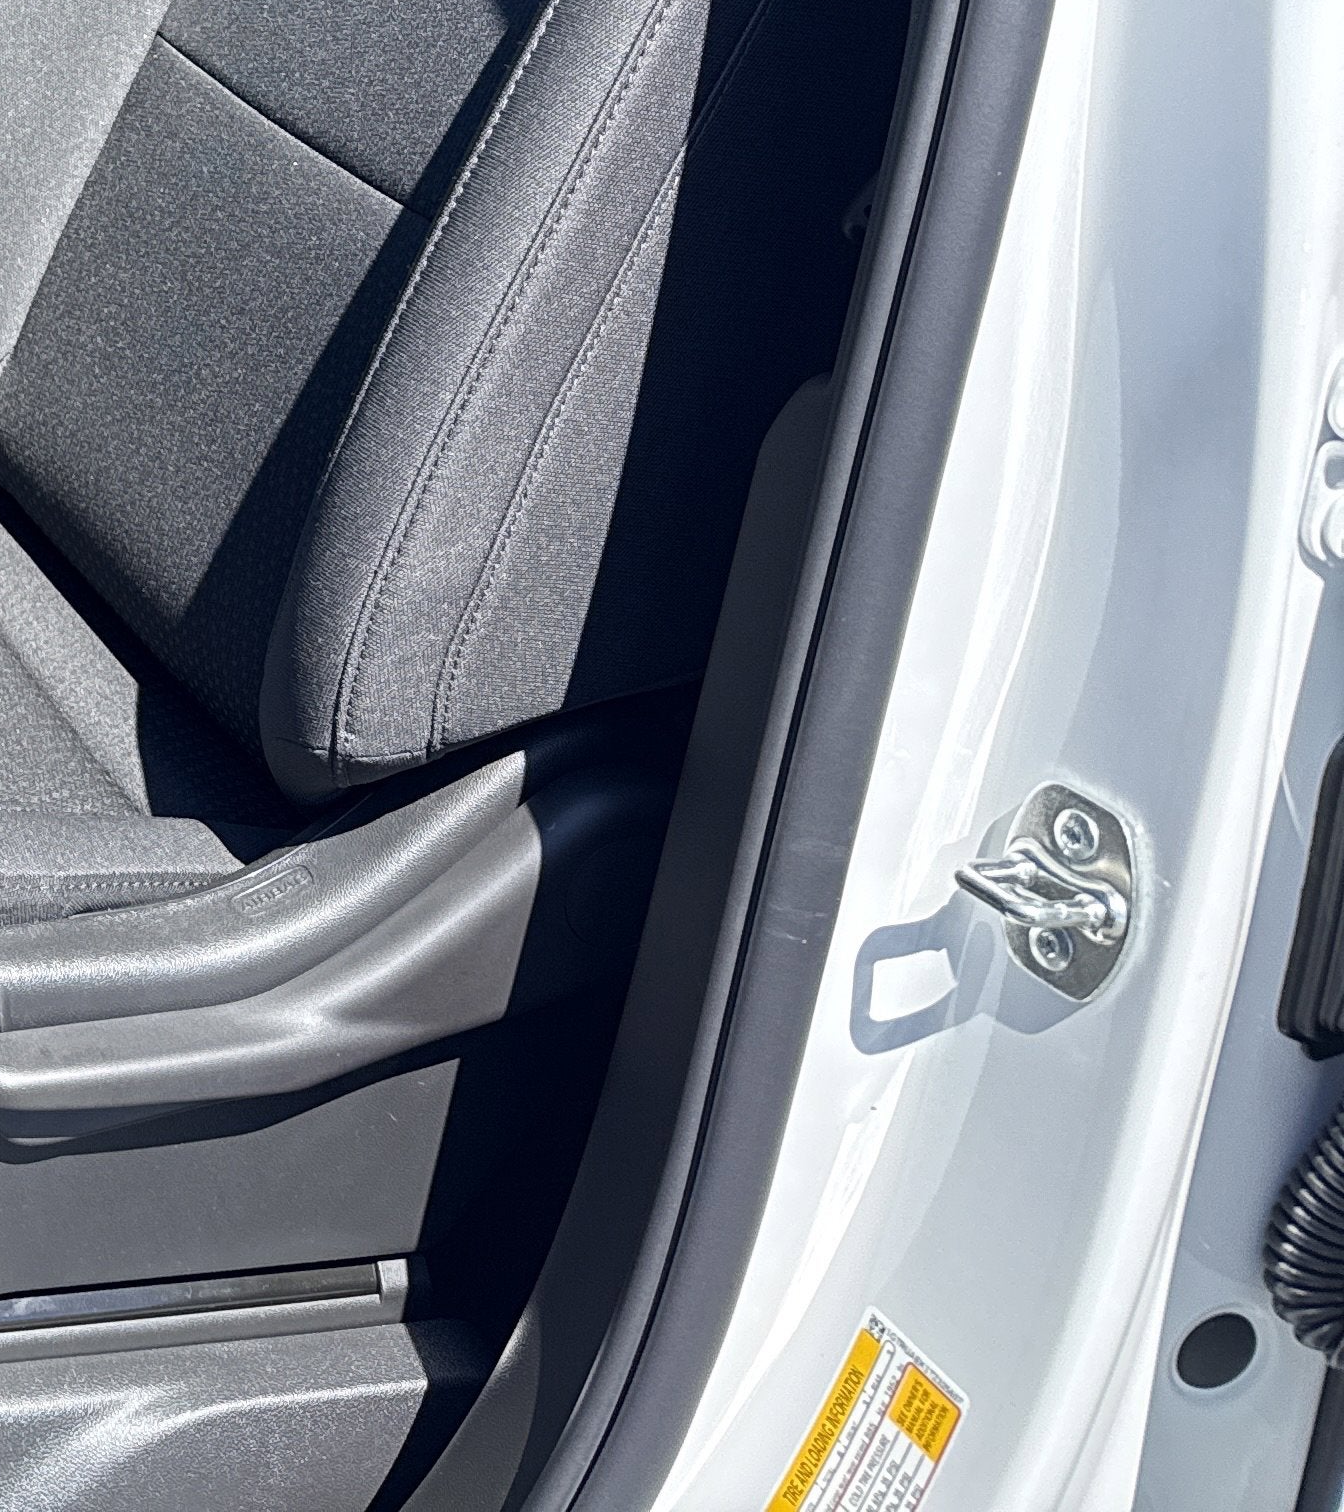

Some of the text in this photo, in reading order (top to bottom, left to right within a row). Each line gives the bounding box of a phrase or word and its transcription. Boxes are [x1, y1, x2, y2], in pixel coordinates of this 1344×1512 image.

[782, 1479, 804, 1506] TIRE
[795, 1461, 814, 1488] AND
[805, 1423, 835, 1469] LOADING
[826, 1364, 865, 1429] INFORMATION
